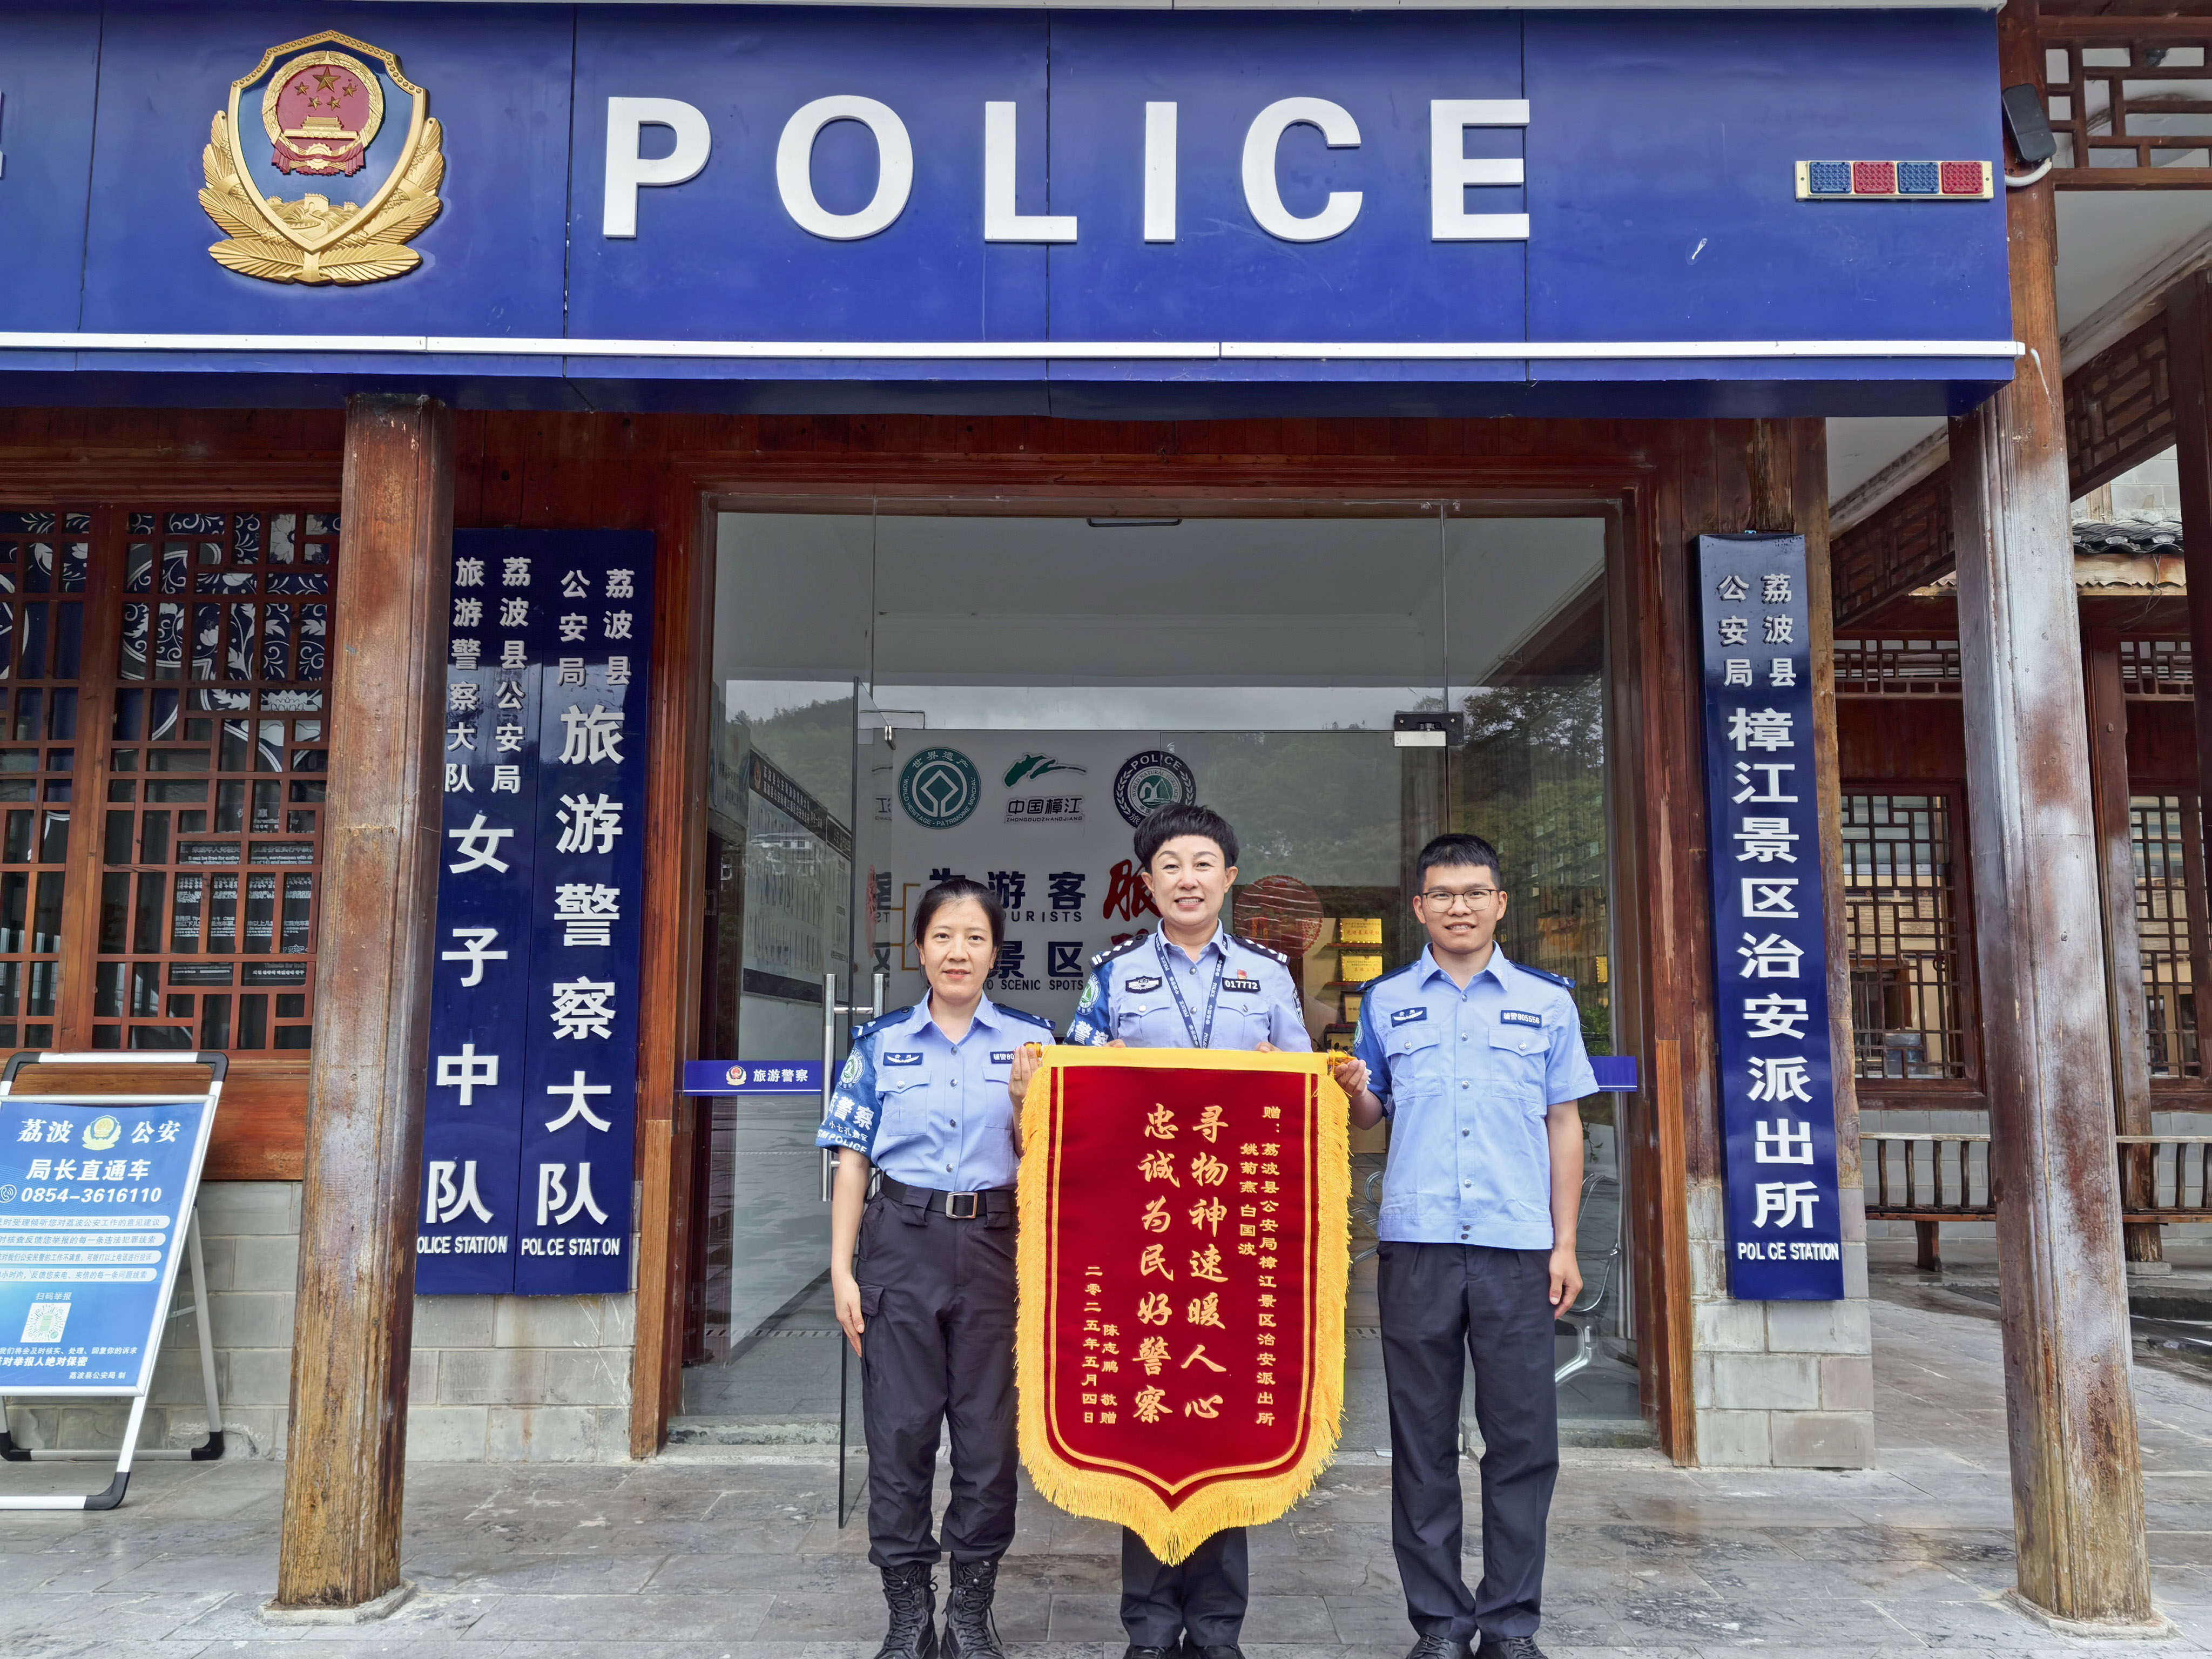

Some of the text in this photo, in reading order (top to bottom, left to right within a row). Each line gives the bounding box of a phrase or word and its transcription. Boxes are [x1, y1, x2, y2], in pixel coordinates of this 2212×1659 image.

[602, 94, 1530, 244] POLICE
[557, 569, 591, 687] 公安局
[603, 568, 635, 686] 荔波县
[1717, 574, 1752, 687] 公安局
[1761, 572, 1797, 687] 荔波县
[444, 557, 485, 793] 旅游警察大队
[491, 556, 531, 794] 荔波县公安局
[1131, 754, 1183, 771] POLICE
[906, 802, 931, 825] HERITAGE
[936, 806, 970, 826] PATRIMOINE
[1008, 798, 1082, 814] 中国樟江
[536, 704, 625, 1226] 旅游警察大队
[1727, 707, 1820, 1229] 樟江景区治安派出所
[1001, 980, 1041, 990] SCENIC
[1049, 980, 1084, 990] SPOTS
[1225, 980, 1258, 990] 017772
[426, 813, 514, 1224] 女子中队
[1503, 1012, 1540, 1024] 辅警805556
[753, 1069, 808, 1083] 旅游警察
[16, 1118, 181, 1144] 荔波 公安
[828, 1134, 867, 1154] POLICE
[26, 1158, 151, 1181] 局长直通车
[21, 1187, 162, 1203] 0854-3616110
[1238, 1204, 1257, 1256] 白国波
[416, 1236, 508, 1254] OLICE STATION
[1789, 1242, 1839, 1260] STATION
[0, 1270, 147, 1279] 小时内，反馈您来电、来信的每一条问题线索
[1132, 1103, 1181, 1424] 忠诚为民好警察
[1181, 1105, 1229, 1419] 寻物神速暖人心
[36, 1292, 72, 1300] 扫码举报
[1082, 1266, 1103, 1424] 二零二五年五月四日
[69, 1371, 126, 1380] 荔波县公安局 制
[1100, 1324, 1120, 1425] 陈志鹏 敬赠
